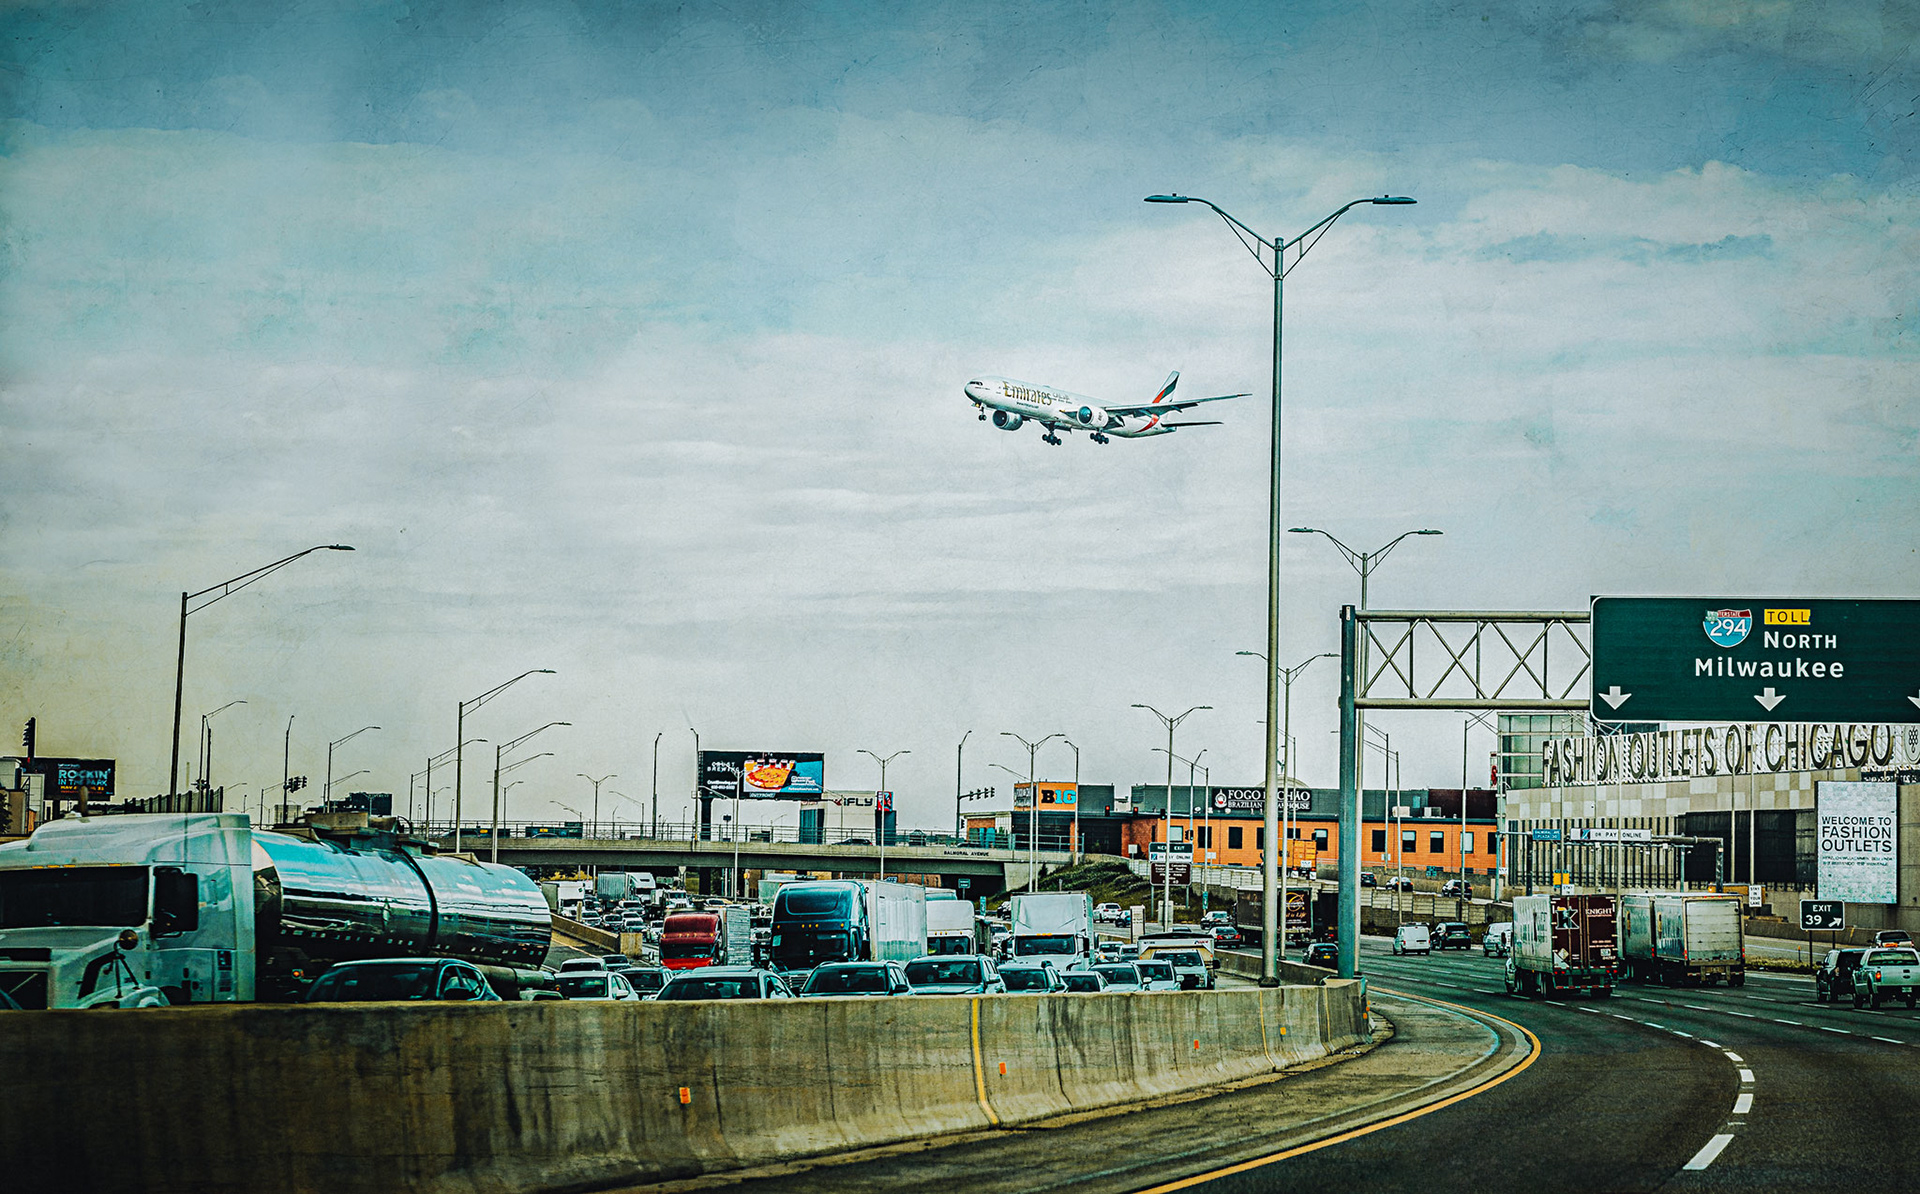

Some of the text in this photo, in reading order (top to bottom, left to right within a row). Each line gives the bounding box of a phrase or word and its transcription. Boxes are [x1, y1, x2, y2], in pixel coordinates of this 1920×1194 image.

[1003, 381, 1052, 405] Emirates
[1767, 611, 1808, 623] TOLL
[1709, 618, 1748, 637] 294
[1764, 631, 1837, 649] NORTH
[1695, 656, 1844, 678] Milwaukee
[1542, 736, 1621, 784] FASHION
[1630, 726, 1718, 779] OUTLETS
[1765, 723, 1893, 772] CHICAGO
[1228, 790, 1261, 800] FOGO
[1822, 816, 1892, 826] WELCOME TO
[1822, 826, 1891, 839] FASHION
[1822, 839, 1892, 852] OUTLETS
[1805, 914, 1823, 925] 39
